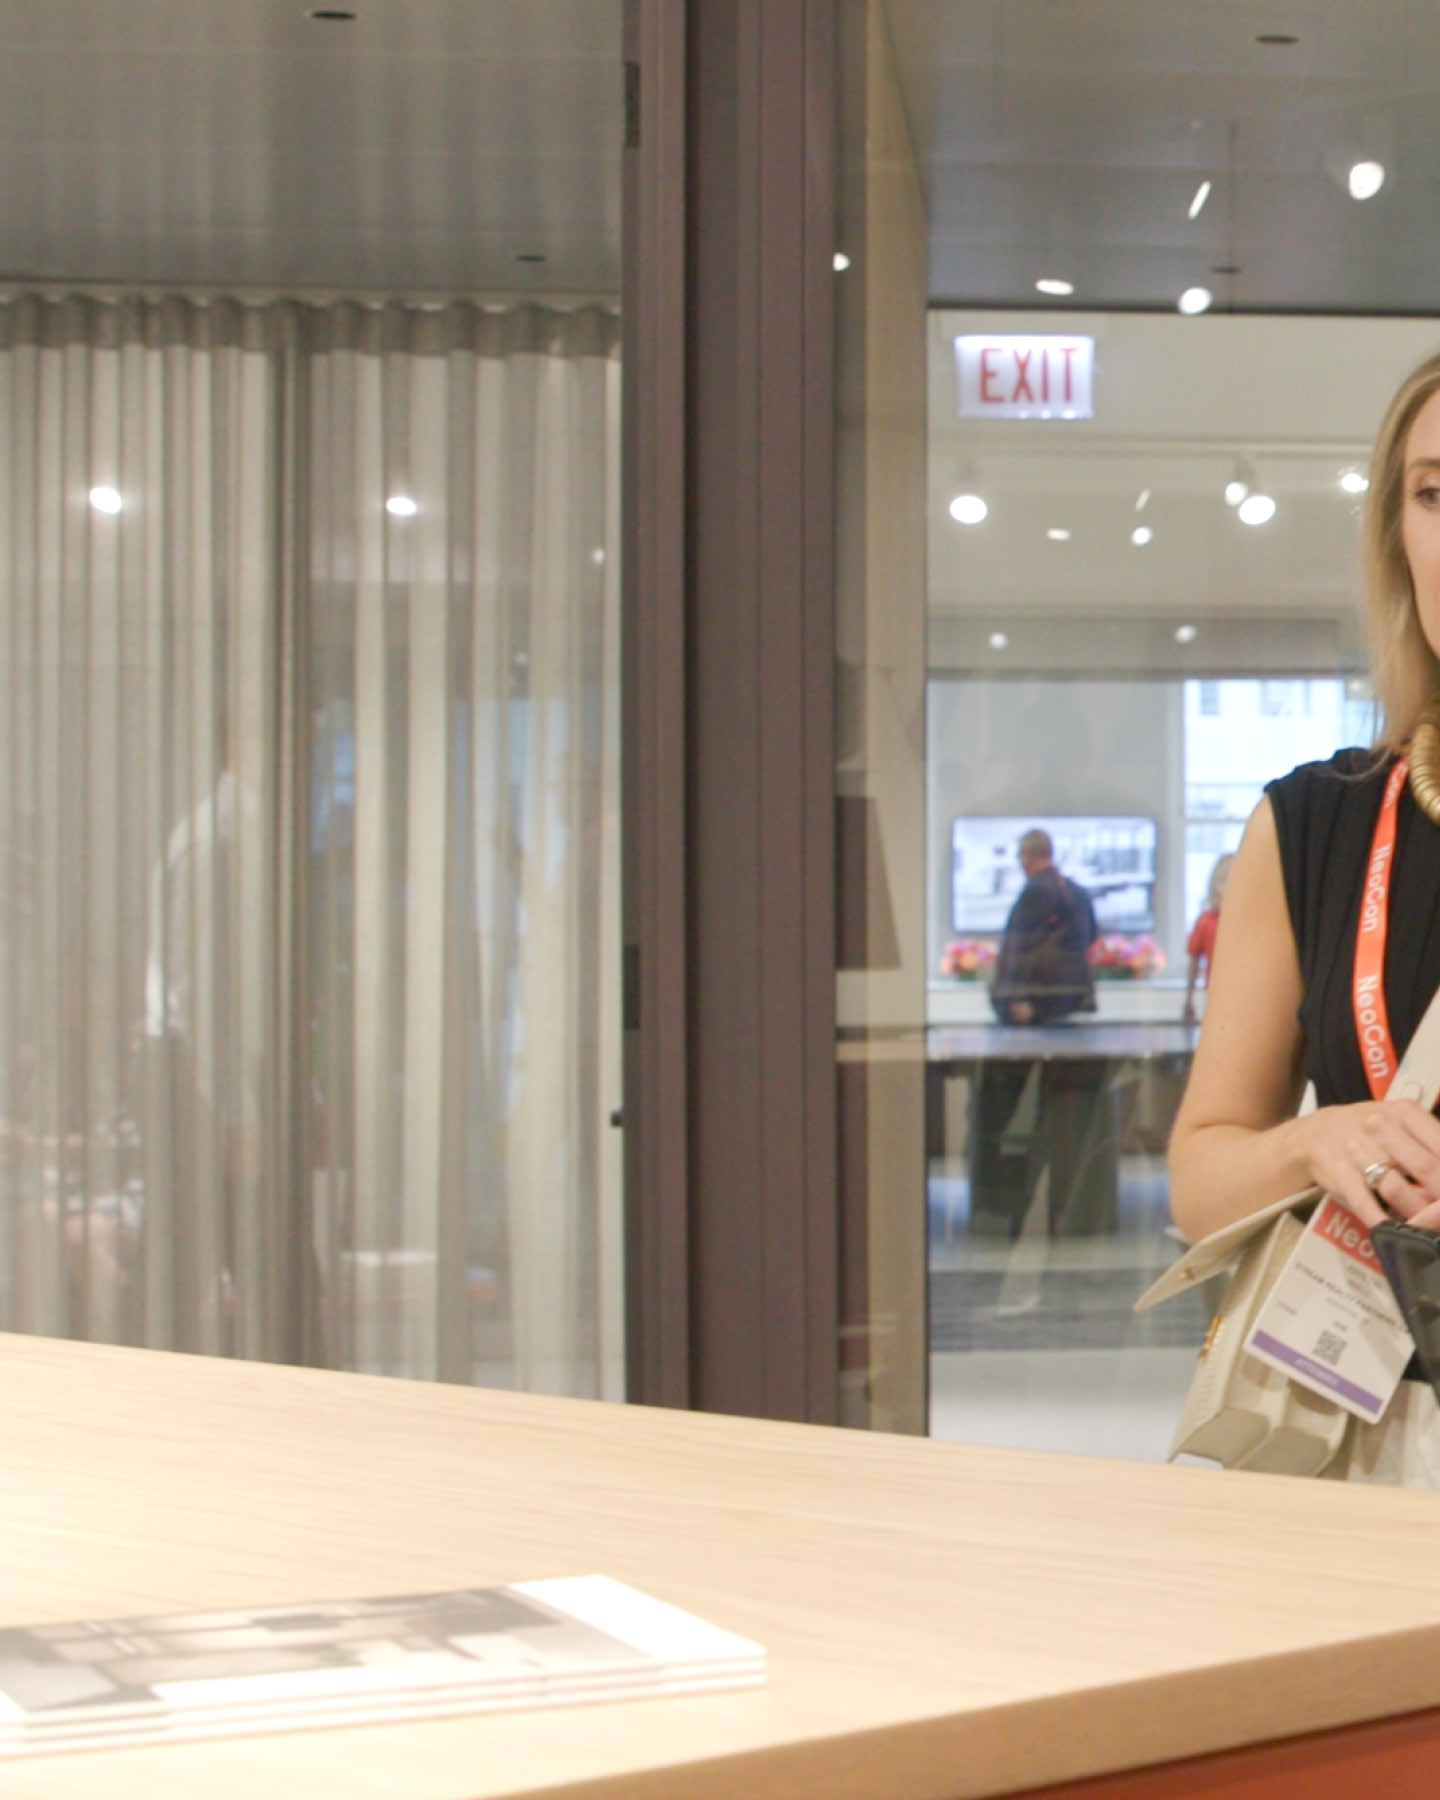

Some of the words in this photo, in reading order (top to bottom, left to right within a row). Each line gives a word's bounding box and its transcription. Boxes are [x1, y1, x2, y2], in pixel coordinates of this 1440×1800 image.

[979, 348, 1078, 403] EXIT
[1361, 843, 1393, 932] NeoCon
[1357, 974, 1389, 1078] NeoCon
[1324, 1210, 1375, 1258] Neo
